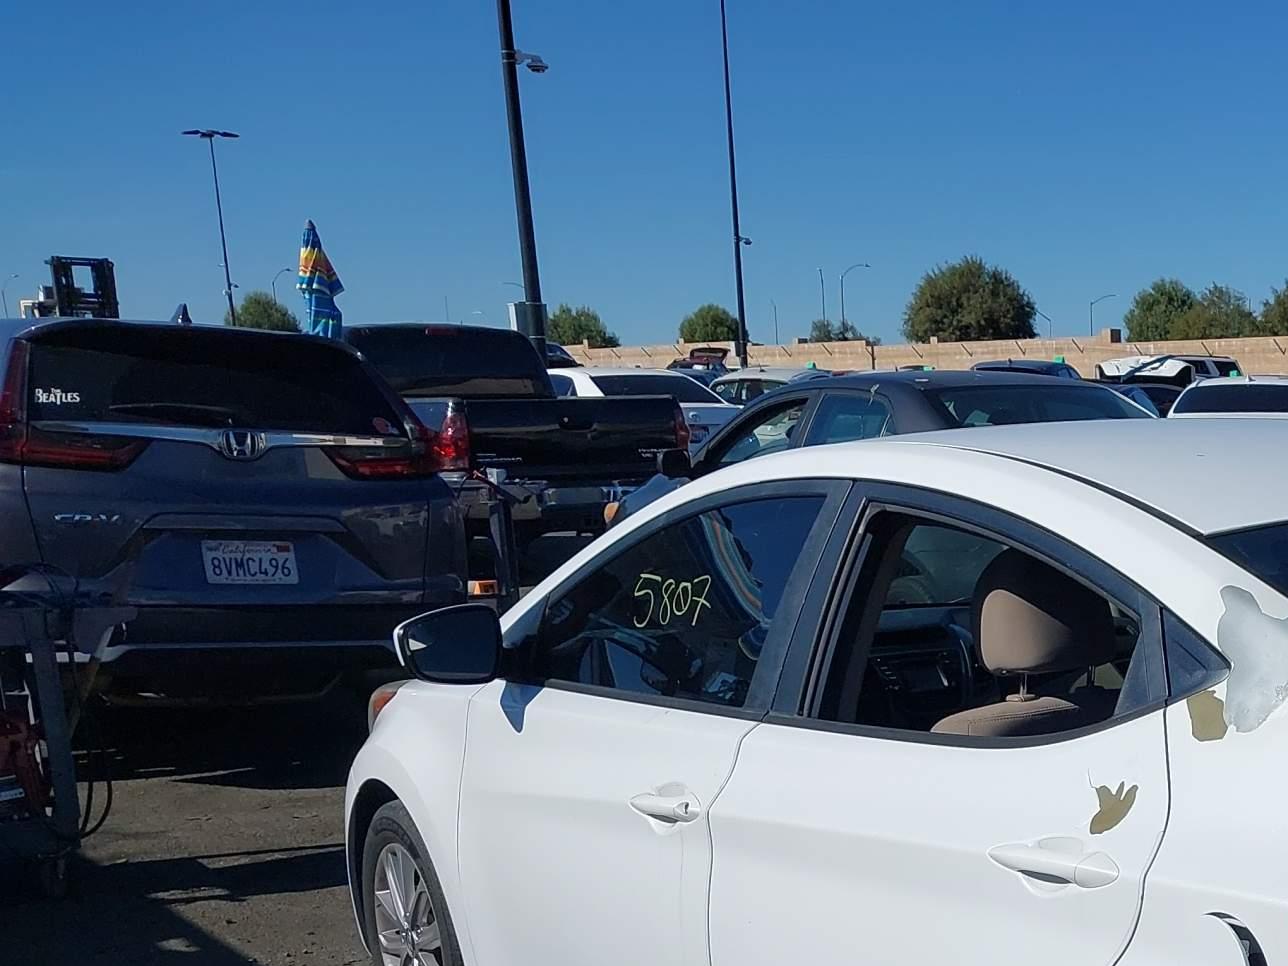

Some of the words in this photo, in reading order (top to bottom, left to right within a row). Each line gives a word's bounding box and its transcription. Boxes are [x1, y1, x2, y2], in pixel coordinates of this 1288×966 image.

[35, 388, 80, 405] BEATLES
[211, 556, 292, 577] 8VMC496
[633, 573, 712, 628] 5807
